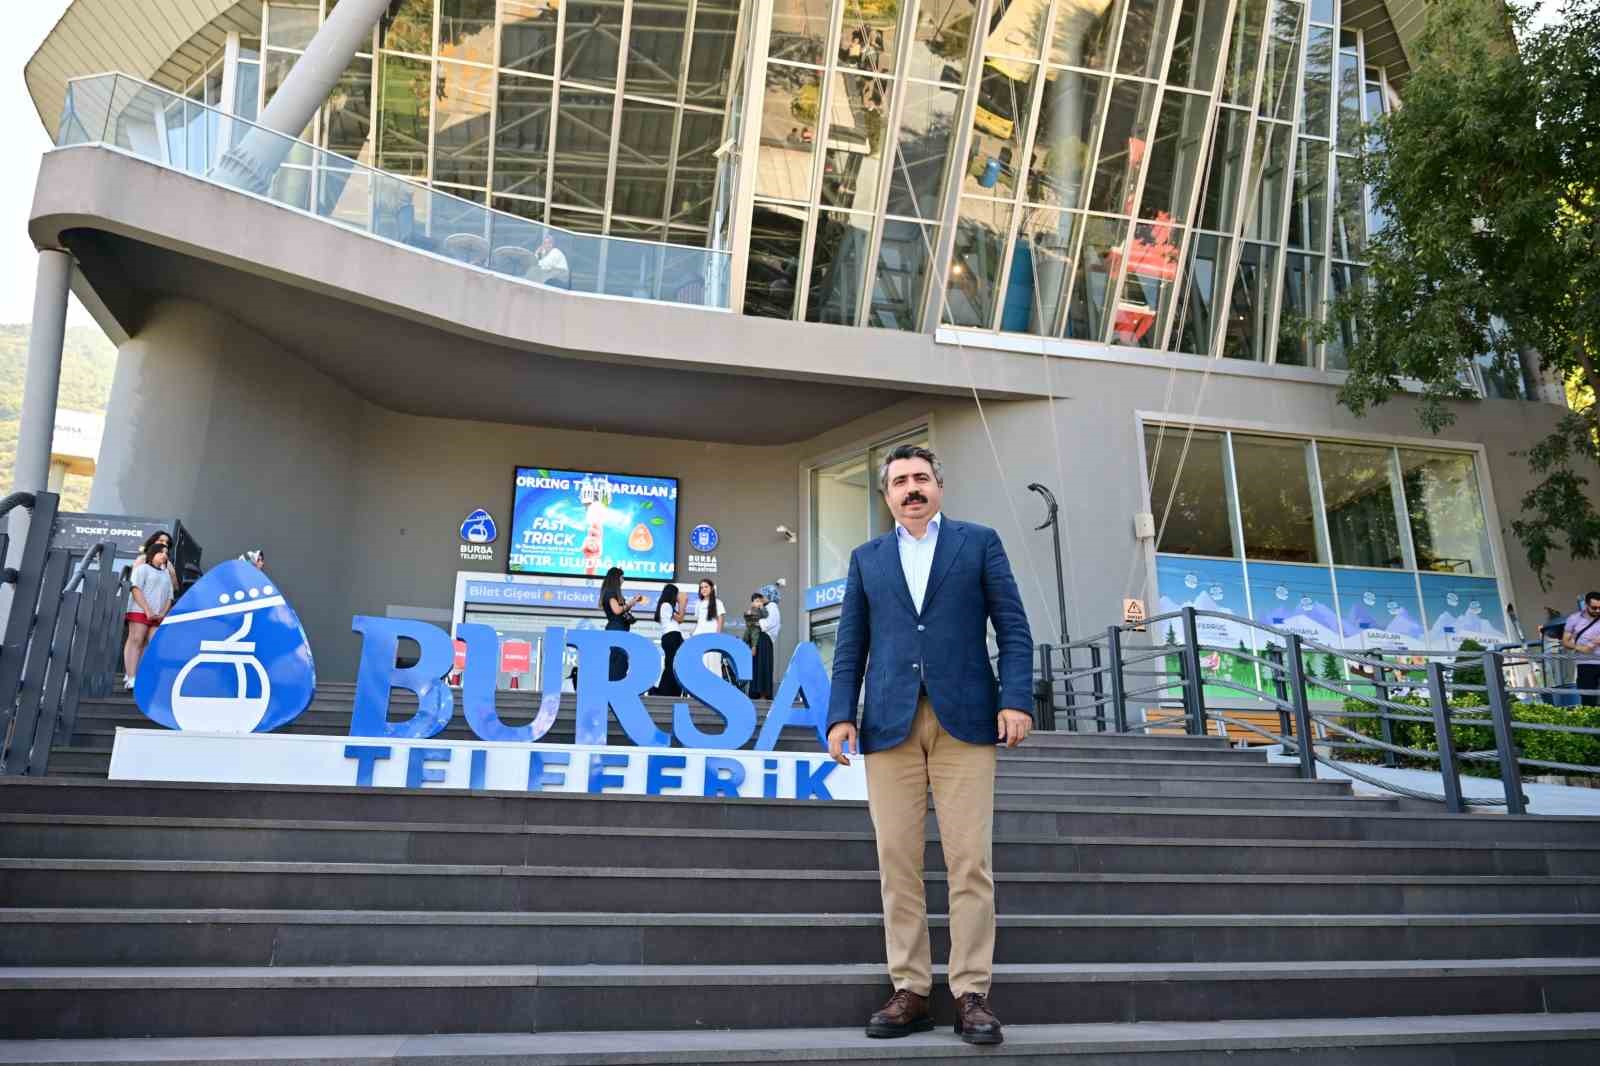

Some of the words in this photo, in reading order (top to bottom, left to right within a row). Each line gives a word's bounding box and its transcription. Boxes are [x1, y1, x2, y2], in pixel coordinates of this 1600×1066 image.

[516, 476, 570, 490] ORKING
[532, 517, 567, 531] FAST
[75, 526, 108, 535] TICKET
[110, 528, 143, 537] OFFICE
[523, 530, 575, 546] TRACK
[460, 544, 493, 554] BURSA
[469, 586, 499, 598] Bilet
[556, 590, 594, 602] Ticket
[350, 614, 860, 752] BURSA
